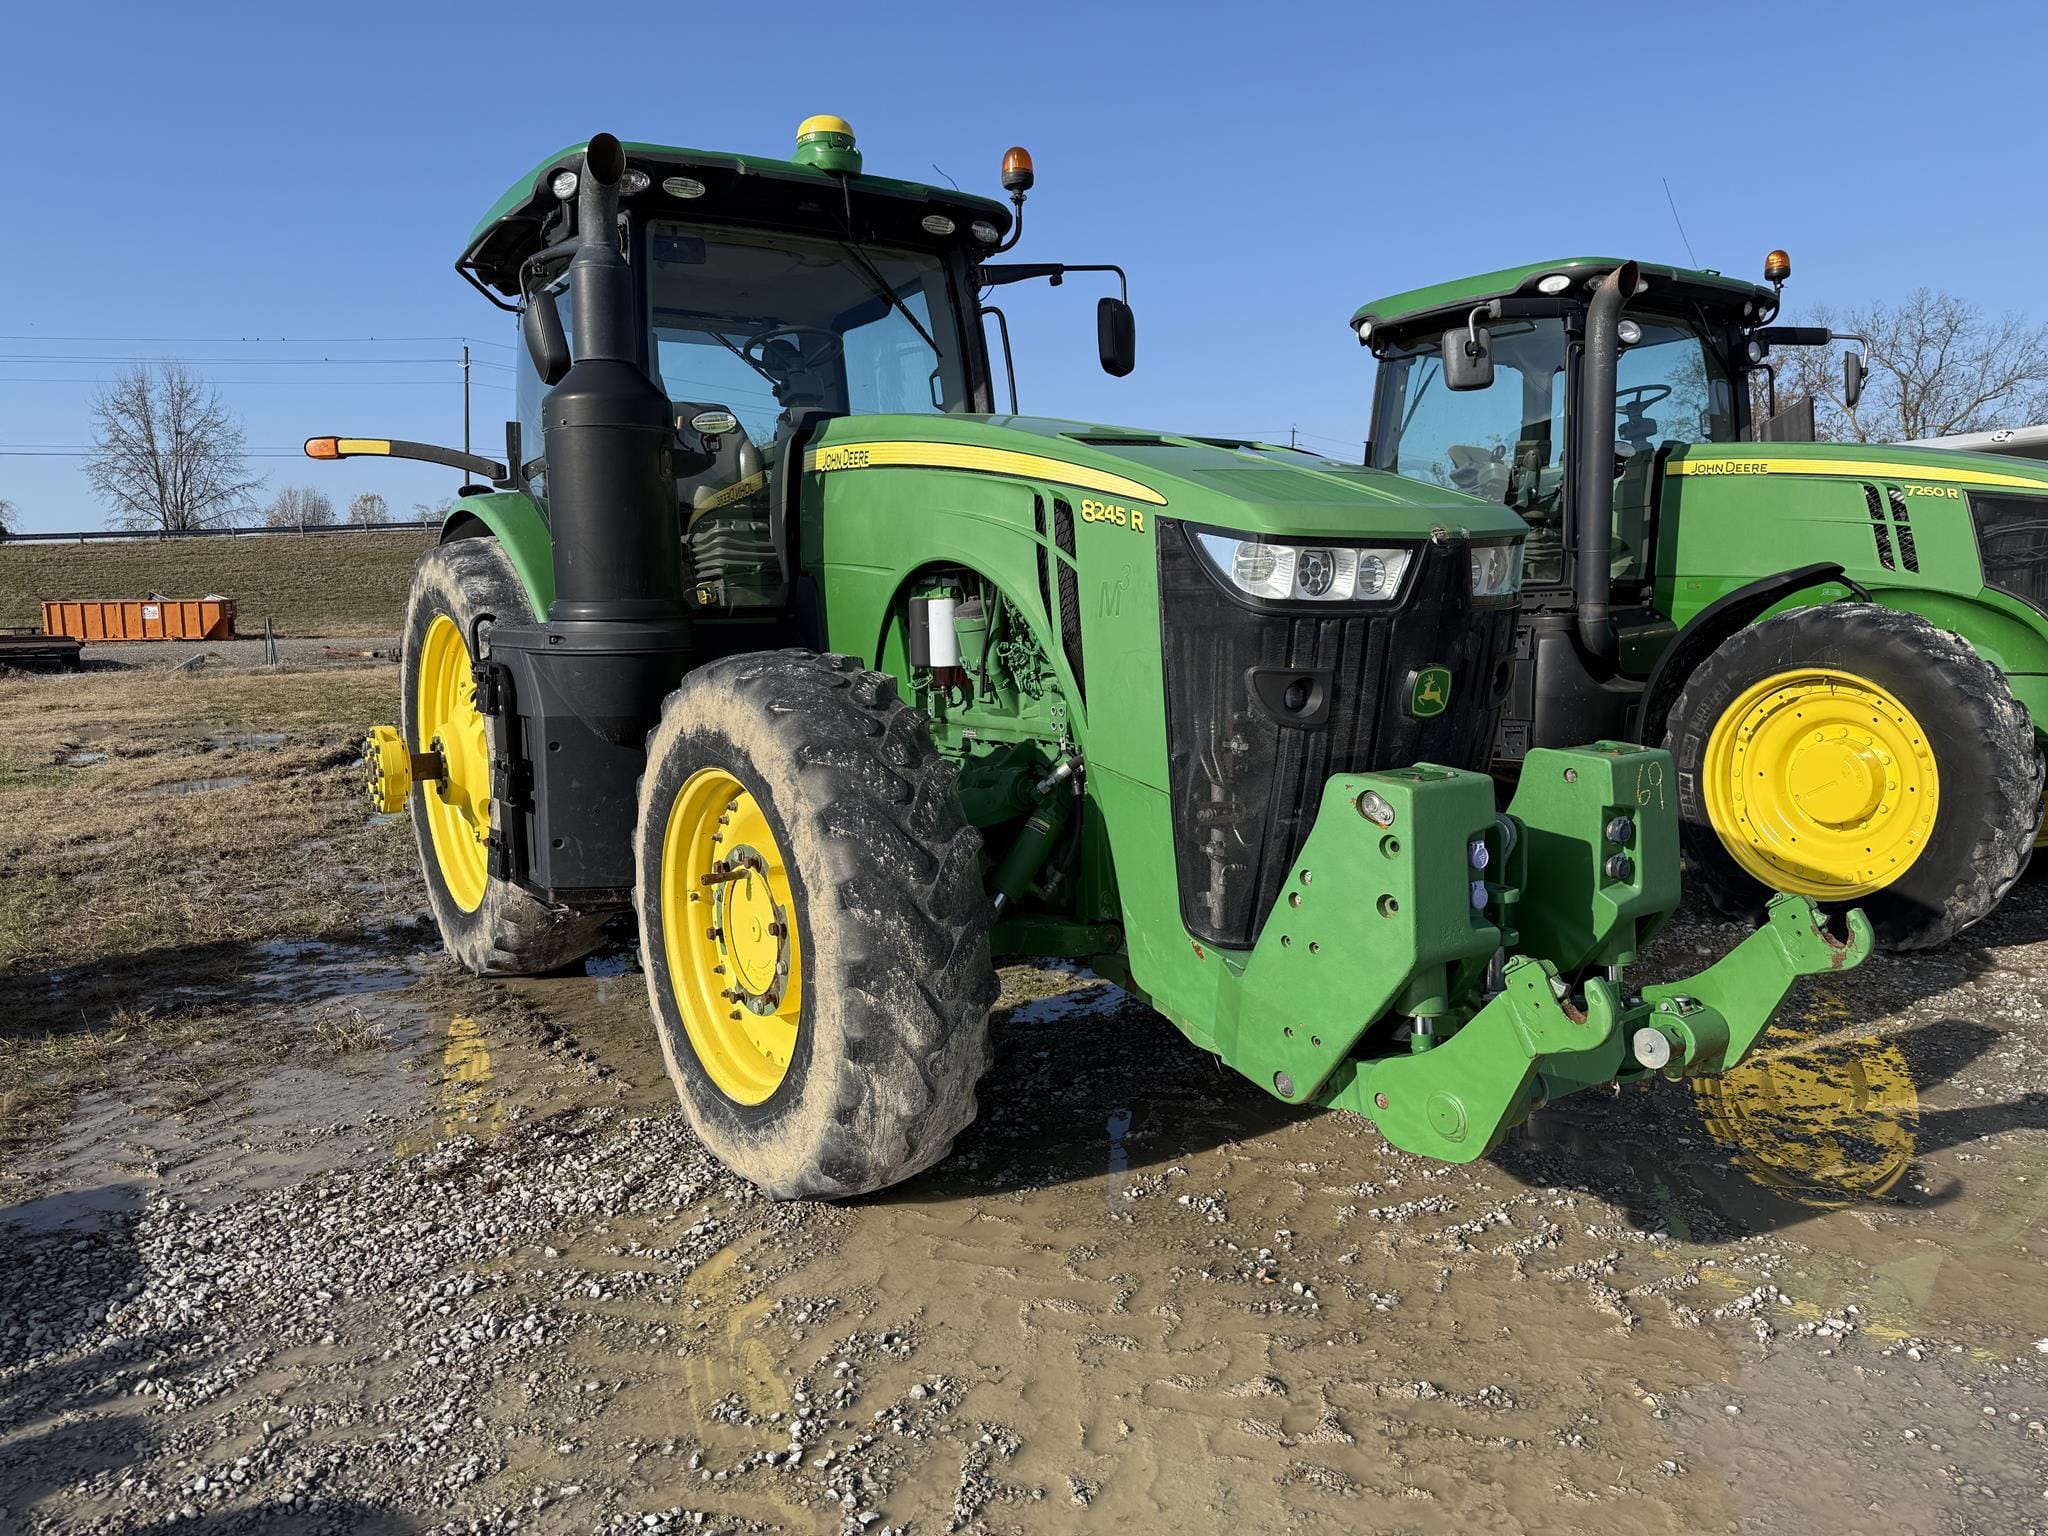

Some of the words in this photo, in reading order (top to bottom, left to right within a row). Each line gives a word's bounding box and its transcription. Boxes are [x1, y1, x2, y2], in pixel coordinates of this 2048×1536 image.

[822, 451, 841, 469] JOHN
[842, 448, 869, 466] DEERE
[1691, 462, 1723, 473] JOHN
[1725, 461, 1768, 473] DEERE
[1904, 484, 1945, 497] 7260
[1947, 487, 1959, 499] R
[1081, 499, 1127, 526] 8245
[1130, 509, 1145, 533] R
[1637, 761, 1664, 811] 69
